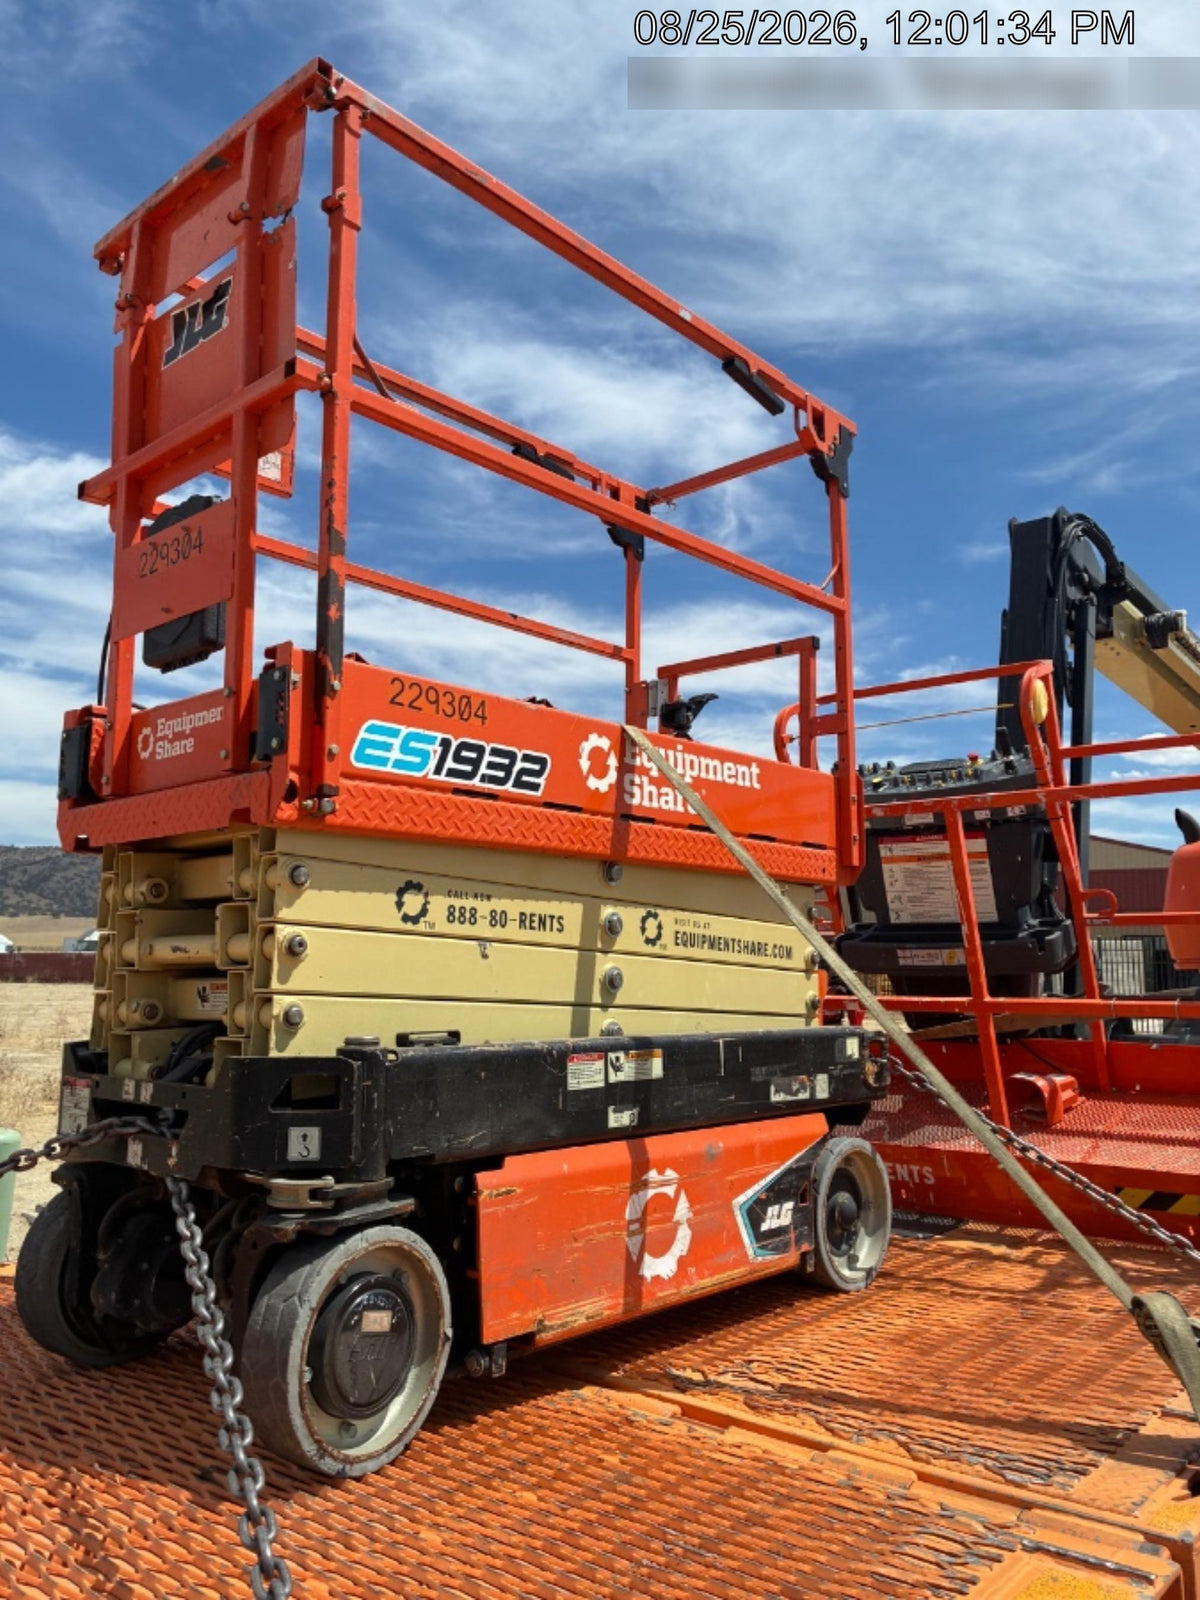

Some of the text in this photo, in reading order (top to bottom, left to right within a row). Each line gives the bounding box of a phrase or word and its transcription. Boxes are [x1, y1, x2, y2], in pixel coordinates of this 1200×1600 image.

[162, 275, 233, 370] JLG
[139, 525, 204, 578] 229304
[389, 677, 488, 726] 229304
[156, 737, 194, 760] Share
[351, 720, 550, 795] ES1932
[446, 904, 565, 933] 888-80-RENTS
[674, 930, 793, 960] EQUIPMENTSHARE.COM
[884, 1162, 935, 1185] ENTS
[760, 1201, 795, 1232] JLG
